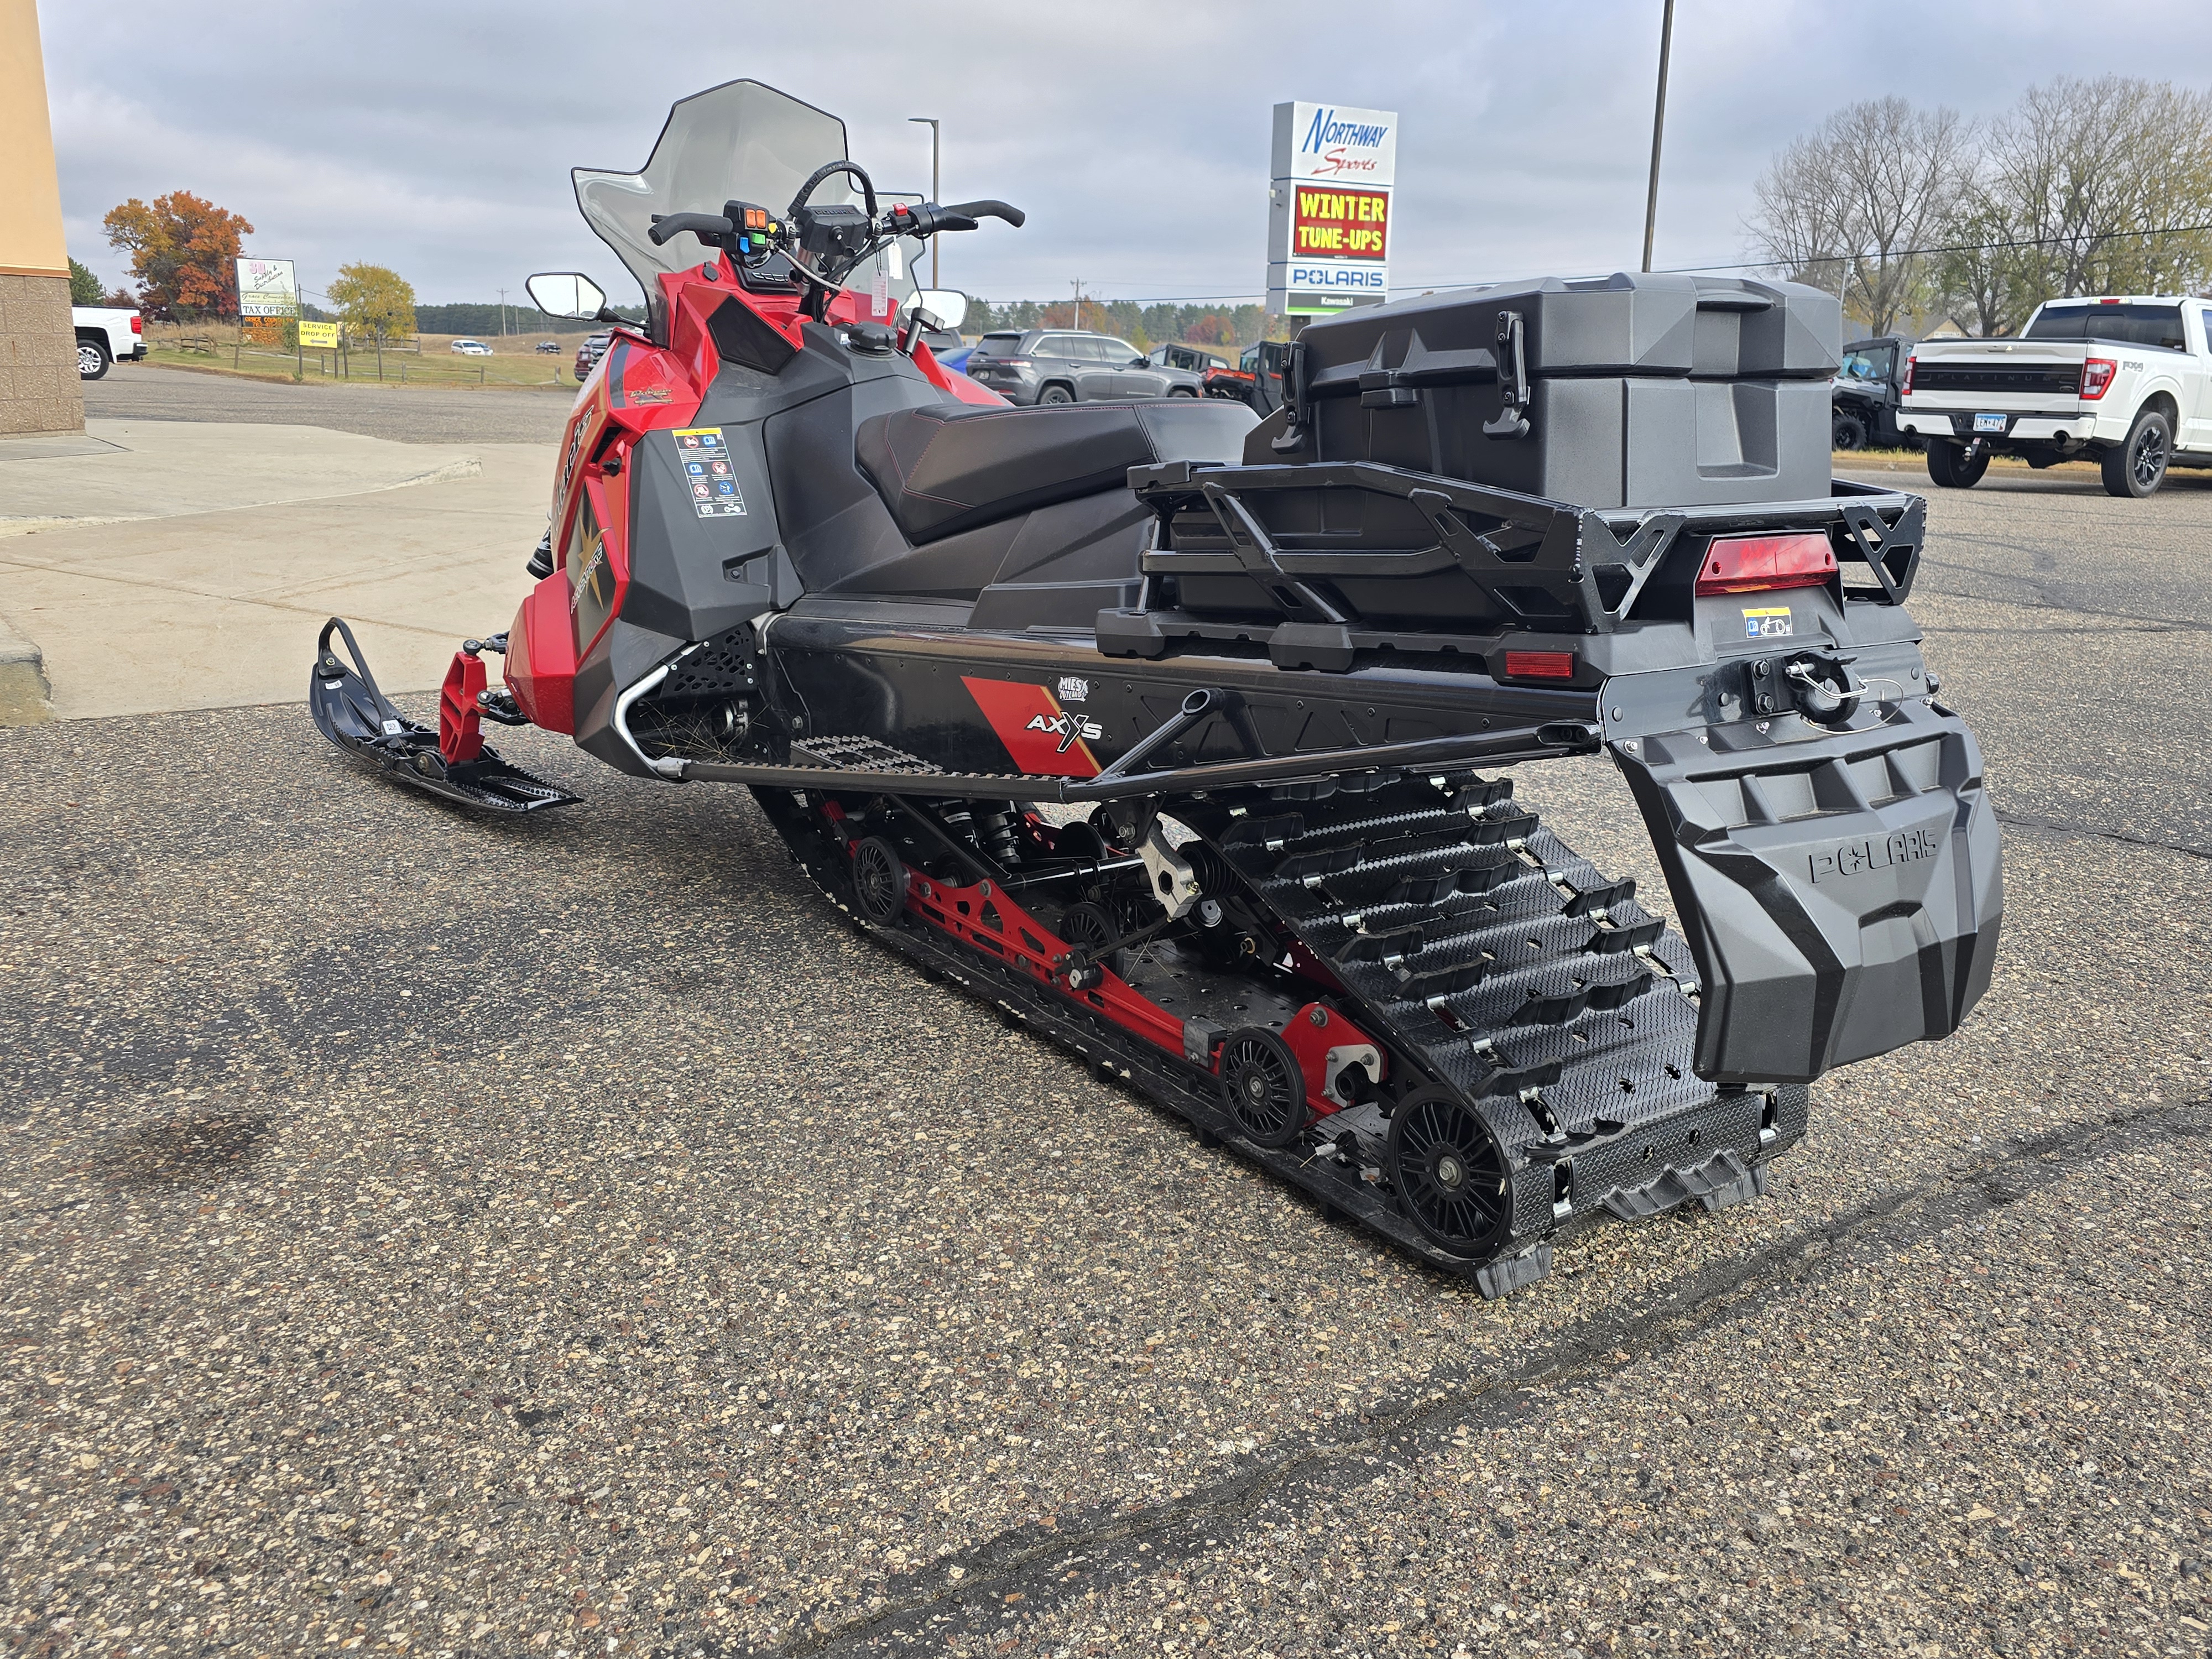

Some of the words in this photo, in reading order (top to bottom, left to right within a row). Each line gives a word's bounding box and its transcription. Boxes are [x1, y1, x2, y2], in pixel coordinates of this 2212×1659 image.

[1302, 108, 1389, 154] NORTHWAY
[1311, 148, 1378, 175] Sports
[1300, 192, 1385, 222] WINTER
[1298, 226, 1383, 251] TUNE-UPS
[1293, 269, 1383, 286] POLARIS
[243, 306, 262, 314] TAX
[263, 306, 296, 315] OFFICE
[1321, 296, 1353, 306] Kawasaki
[1060, 677, 1082, 691] MIES
[1026, 711, 1103, 753] AXYS
[1809, 830, 1937, 883] POLARIS
